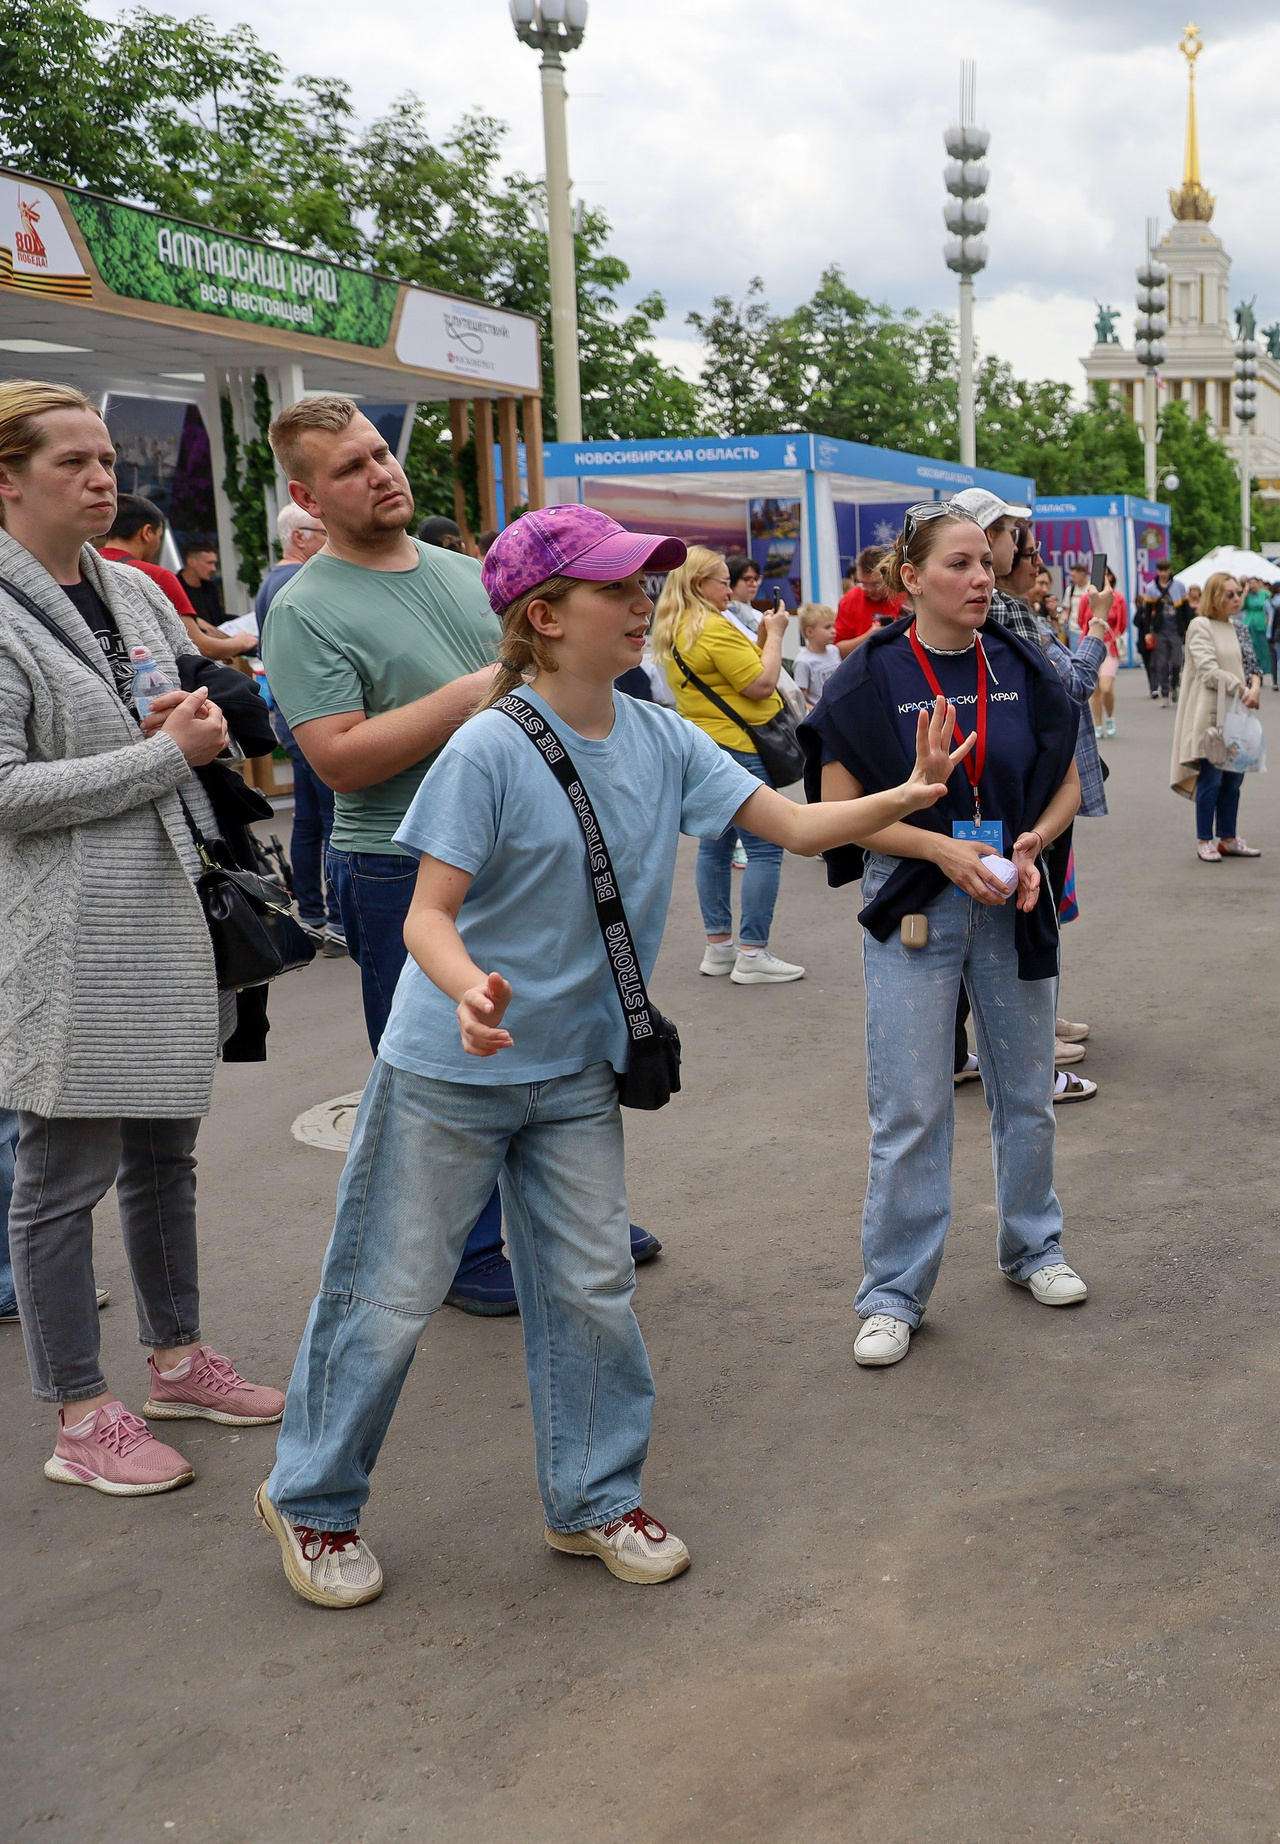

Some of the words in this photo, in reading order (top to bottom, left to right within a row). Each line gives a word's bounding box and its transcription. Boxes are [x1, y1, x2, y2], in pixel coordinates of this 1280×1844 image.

[15, 231, 34, 253] 80
[17, 251, 48, 269] ПОБЕДА!
[157, 228, 286, 291] АЛТАЙСКИЙ
[290, 260, 338, 304] КРАЙ
[231, 289, 314, 325] настоящее!
[574, 448, 693, 465] НОВОСИБИРСКАЯ
[695, 446, 760, 462] ОБЛАСТЬ
[1035, 503, 1077, 513] ОБЛАСТЬ
[491, 696, 544, 735] STRO
[897, 694, 987, 714] КРАСНРСКИ
[990, 692, 1019, 702] КРАЙ
[536, 731, 565, 764] BE
[568, 780, 607, 872] STRONG
[594, 872, 617, 903] BE
[605, 921, 645, 1010] STRONG
[628, 1010, 653, 1040] BE
